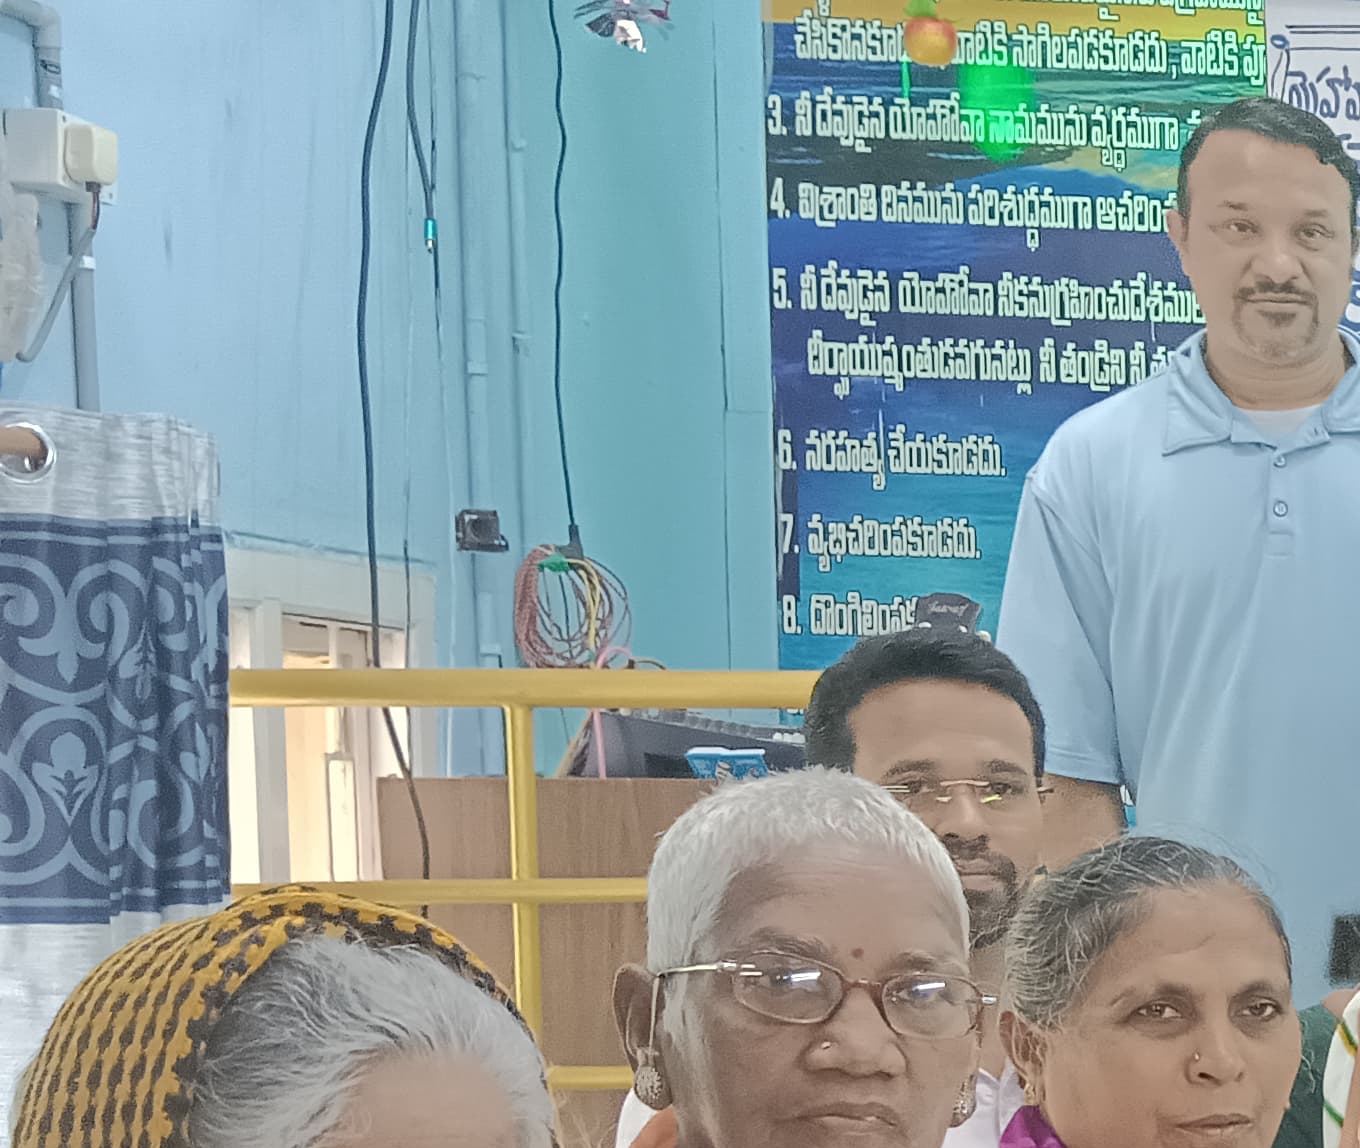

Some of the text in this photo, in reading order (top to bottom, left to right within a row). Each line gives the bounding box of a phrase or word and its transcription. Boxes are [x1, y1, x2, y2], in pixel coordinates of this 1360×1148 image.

[1180, 30, 1239, 76] వాటికి
[768, 95, 788, 137] 3.
[795, 87, 814, 137] నీ
[816, 86, 885, 152] దేవుడైన
[988, 103, 1087, 147] నామమును
[769, 178, 790, 219] 4.
[773, 267, 792, 309] 5.
[800, 263, 818, 311] నీ
[820, 260, 891, 327] దేవుడైన
[1039, 337, 1056, 384] నీ
[777, 428, 797, 470] 6.
[805, 428, 886, 491] నరహత్య
[780, 513, 800, 554] 7.
[782, 594, 803, 636] 8.
